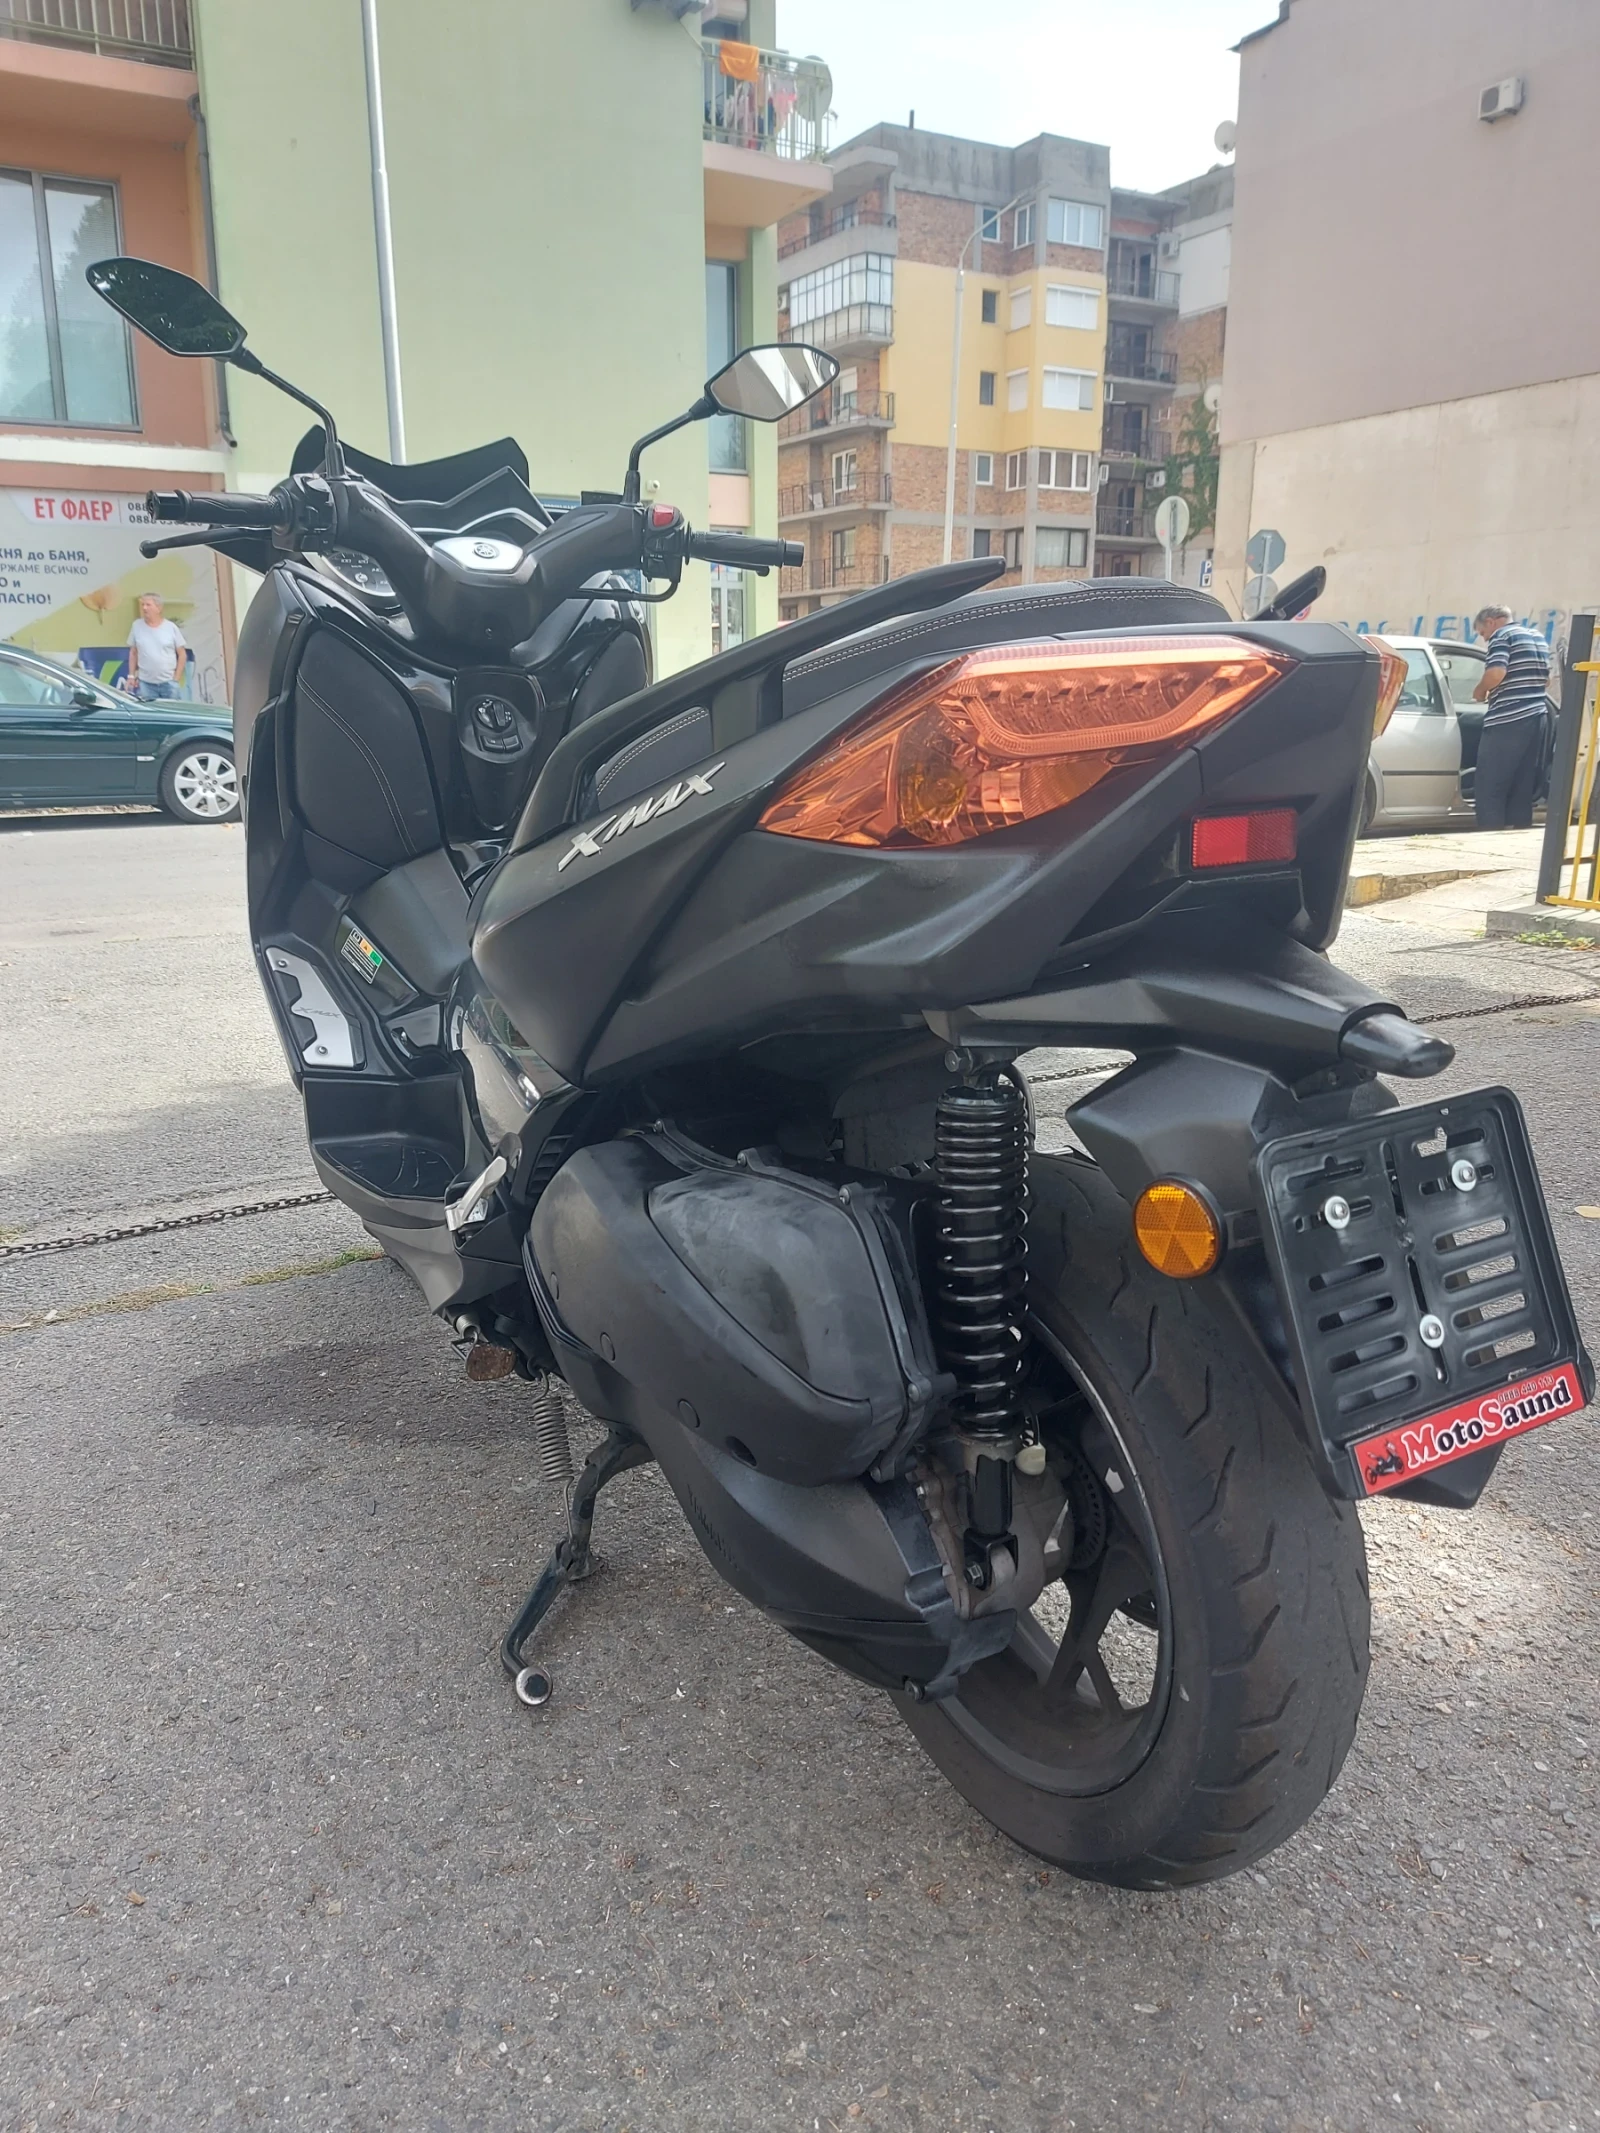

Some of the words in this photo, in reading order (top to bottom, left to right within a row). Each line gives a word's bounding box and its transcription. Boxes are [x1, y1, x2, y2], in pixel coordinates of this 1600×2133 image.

[34, 498, 56, 518] ЕТ
[61, 500, 113, 521] ФАЕР
[28, 552, 45, 560] до
[49, 550, 90, 563] БАНЯ,
[44, 564, 88, 575] ВСИЧКО
[1204, 560, 1212, 573] P
[13, 580, 21, 588] и
[558, 761, 726, 872] XMAX
[1401, 1376, 1573, 1469] MotoSaund
